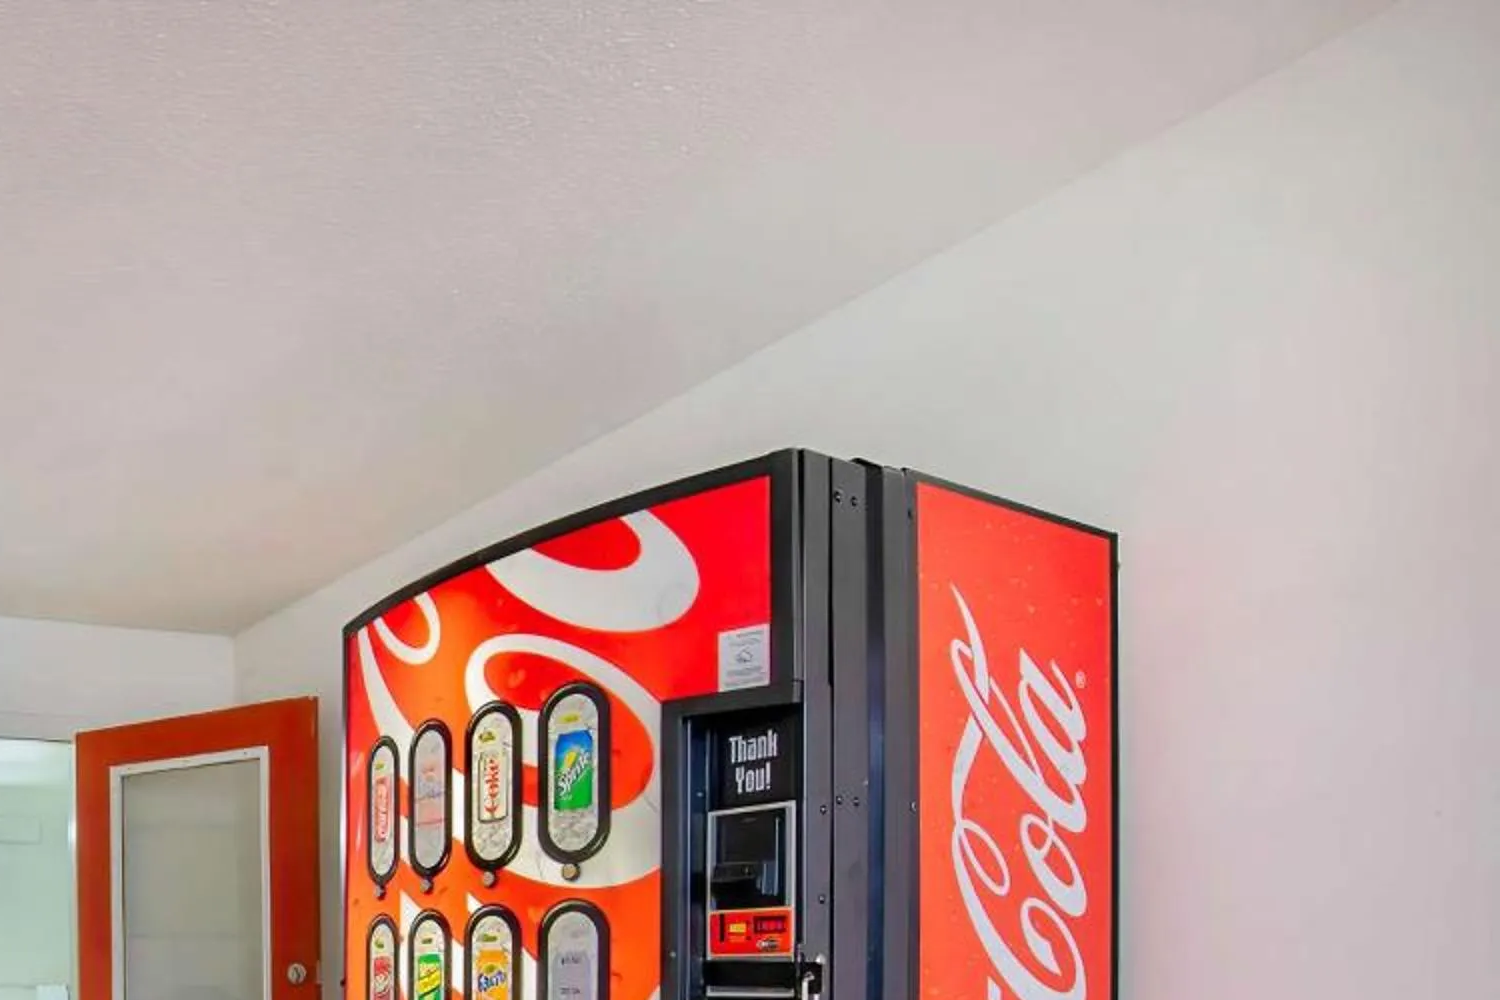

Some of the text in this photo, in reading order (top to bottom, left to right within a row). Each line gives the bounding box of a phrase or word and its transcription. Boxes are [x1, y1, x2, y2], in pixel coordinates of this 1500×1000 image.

[729, 729, 778, 764] Thank
[555, 747, 592, 797] Sprite
[735, 761, 771, 794] You!
